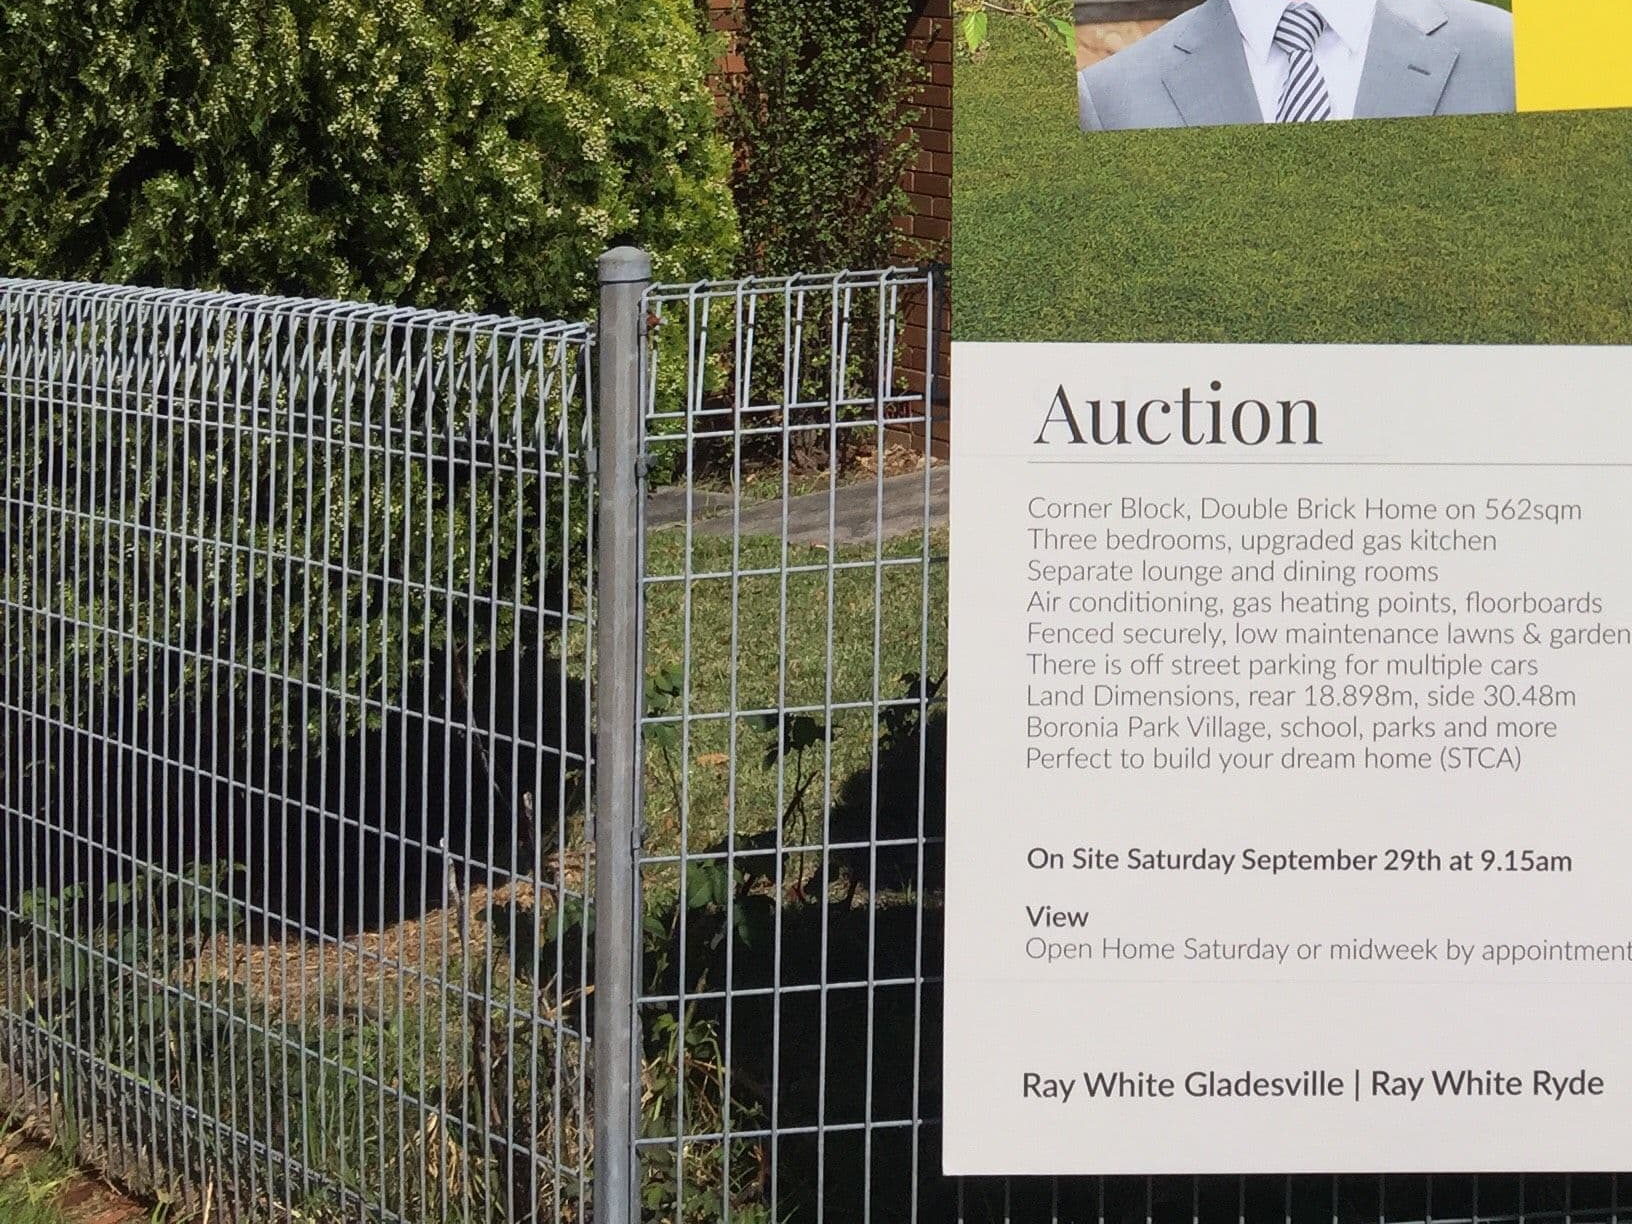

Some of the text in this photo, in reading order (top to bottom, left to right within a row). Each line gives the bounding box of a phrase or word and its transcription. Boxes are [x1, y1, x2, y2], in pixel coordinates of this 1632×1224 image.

[1033, 379, 1324, 446] Auction
[1028, 496, 1582, 525] Corner Block, Double Brick Home on 562sqm
[1026, 527, 1497, 556] Three bedrooms, upgraded gas kitchen
[1027, 559, 1439, 588] Separate lounge and dining rooms
[1026, 590, 1603, 619] Air conditioning, gas heating points, floorboards
[1028, 621, 1114, 645] Fenced
[1123, 621, 1227, 649] securely,
[1235, 621, 1278, 645] low
[1286, 622, 1439, 645] maintenance
[1447, 621, 1515, 645] lawns
[1522, 622, 1542, 645] &
[1025, 652, 1539, 681] There is off street parking for multiple cars
[1027, 684, 1576, 710] Land Dimensions, rear 18.898m, side 30.48m
[1027, 714, 1558, 744] Boronia Park Village, school, parks and more
[1026, 745, 1522, 774] Perfect to build your dream home (STCA)
[1027, 847, 1572, 876] On Site Saturday September 29th at 9.15am
[1025, 905, 1090, 928] View
[1025, 936, 1093, 964] Open
[1102, 937, 1175, 960] Home
[1183, 937, 1290, 965] Saturday
[1296, 943, 1323, 961] or
[1330, 937, 1438, 961] midweek
[1446, 938, 1475, 966] by
[1023, 1072, 1077, 1104] Ray
[1083, 1071, 1175, 1098] White
[1184, 1069, 1345, 1098] Gladesville
[1371, 1070, 1425, 1102] Ray
[1431, 1069, 1523, 1096] White
[1533, 1068, 1605, 1102] Ryde
